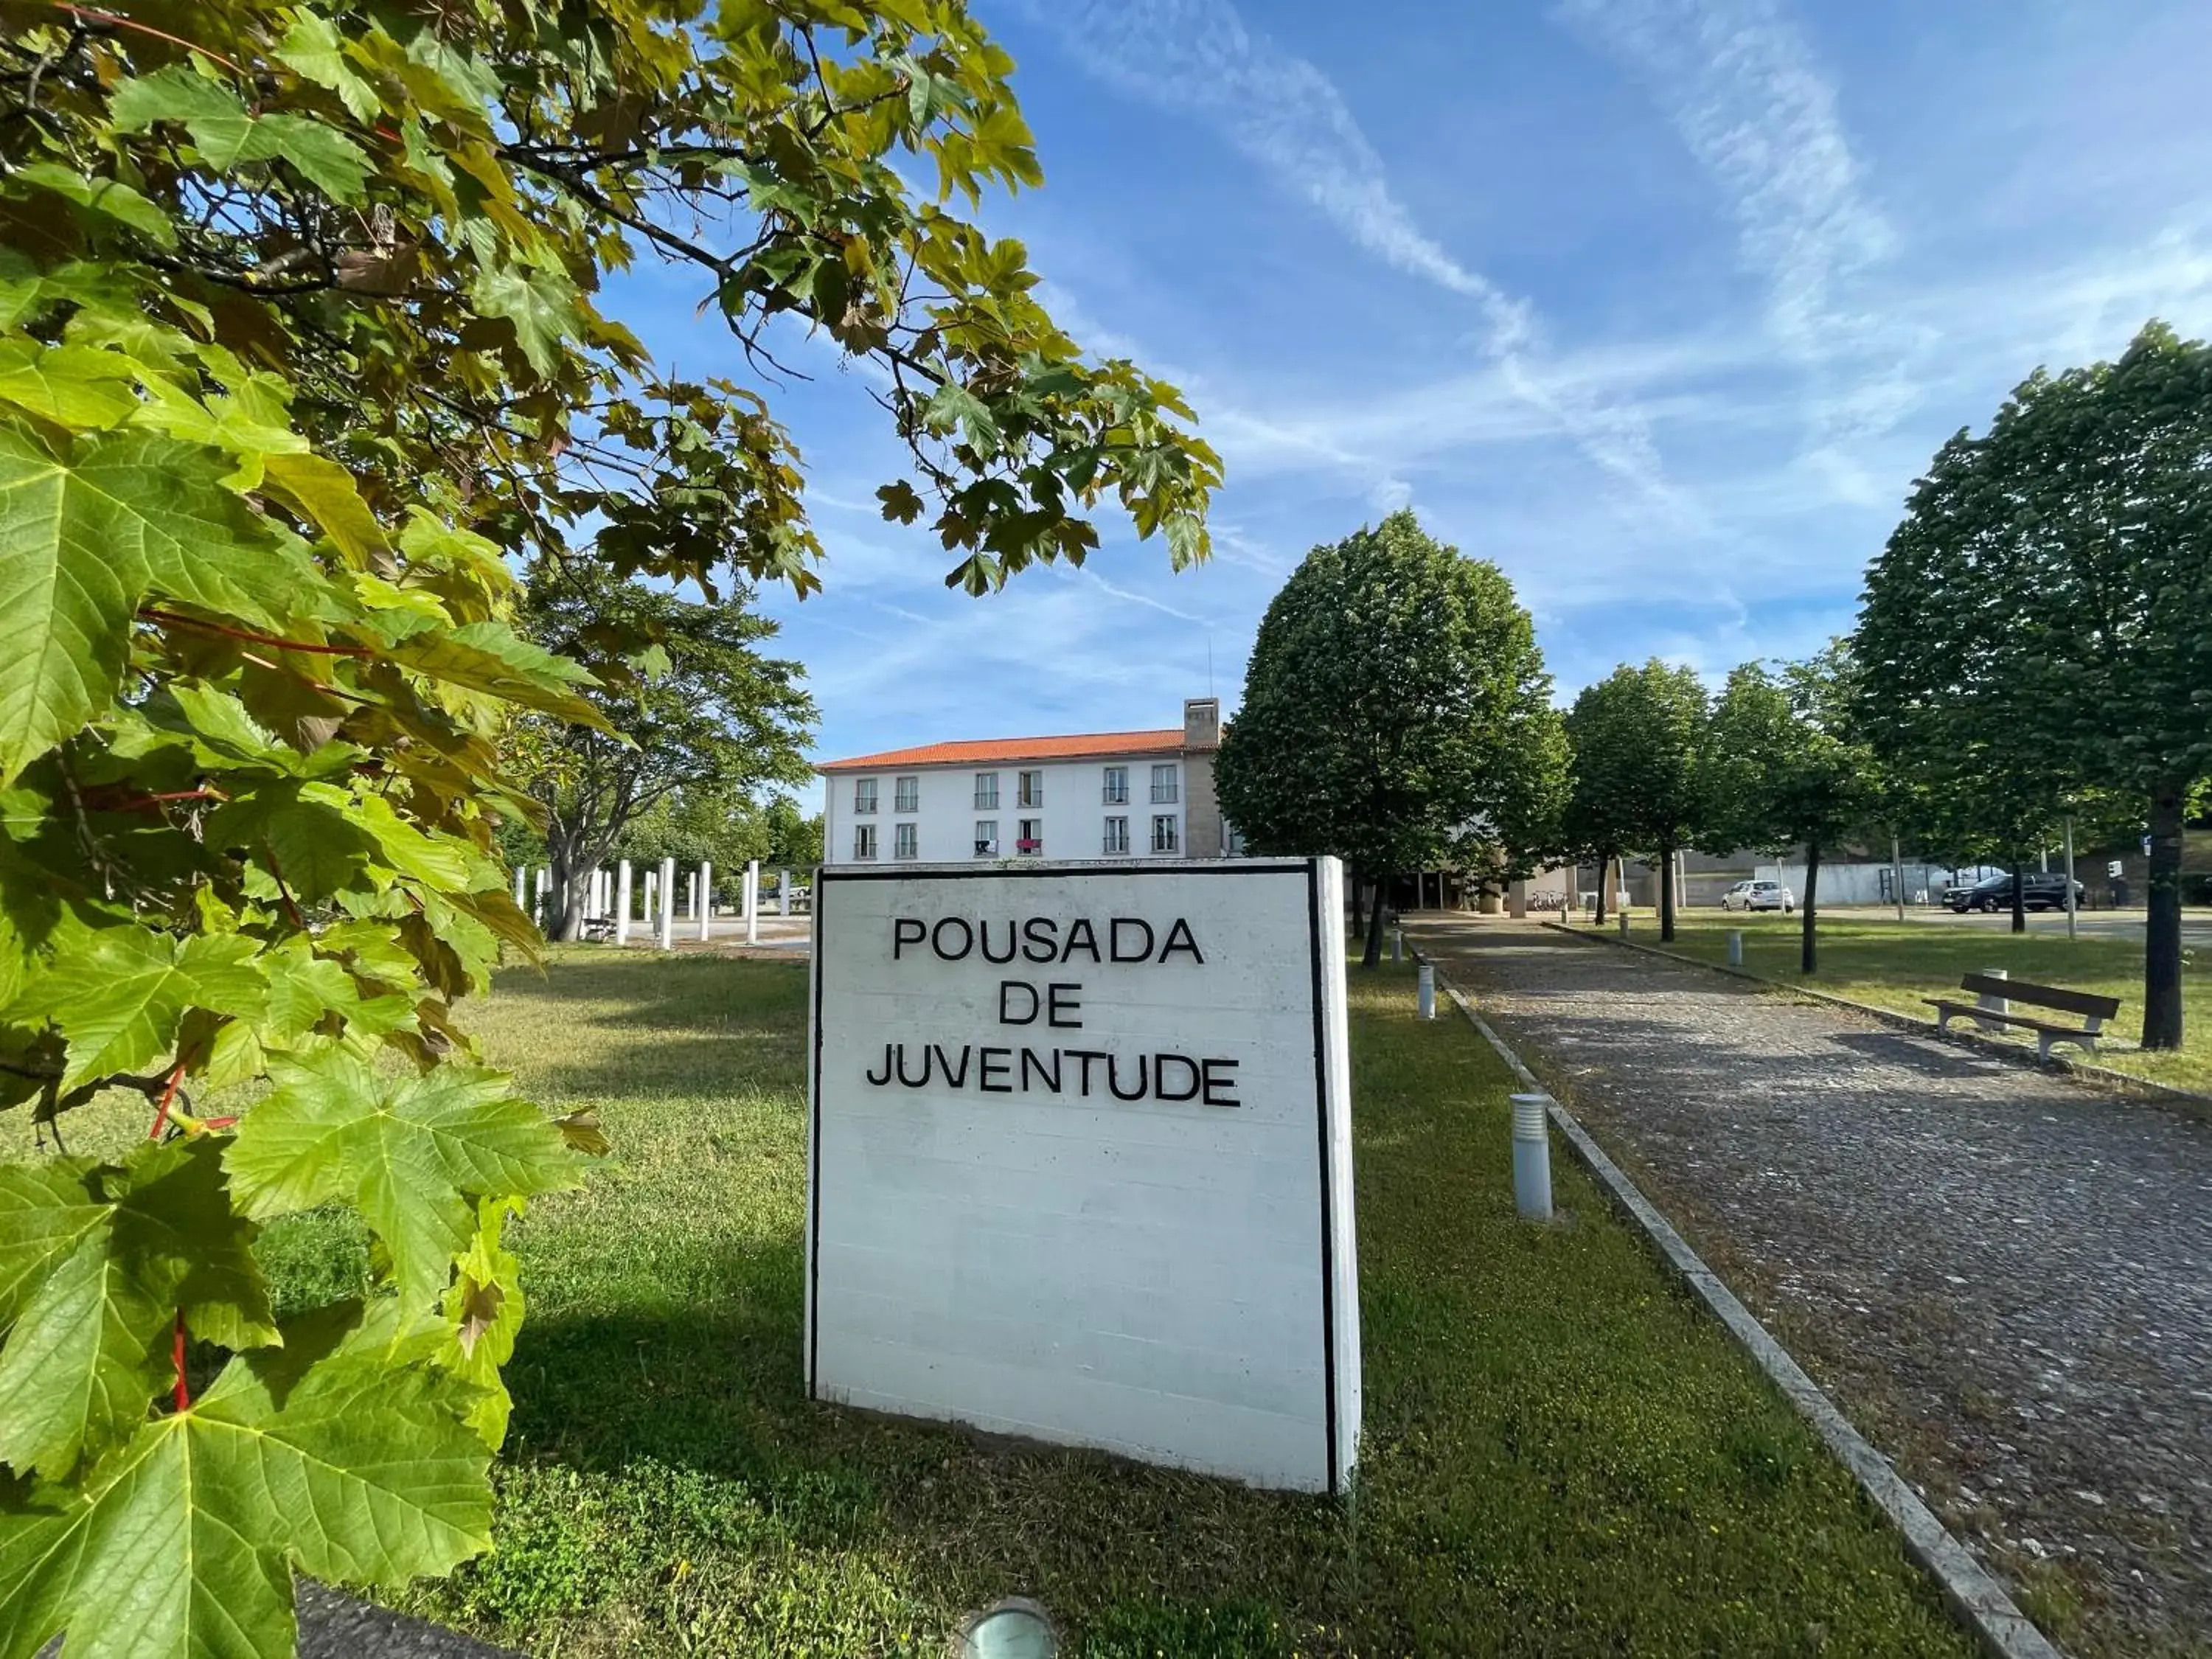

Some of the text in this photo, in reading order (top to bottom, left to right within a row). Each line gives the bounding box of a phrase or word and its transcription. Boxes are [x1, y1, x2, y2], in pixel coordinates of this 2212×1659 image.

[893, 917, 1204, 964] POUSADA
[999, 981, 1083, 1028] DE
[866, 1043, 1241, 1107] JUVENTUDE
